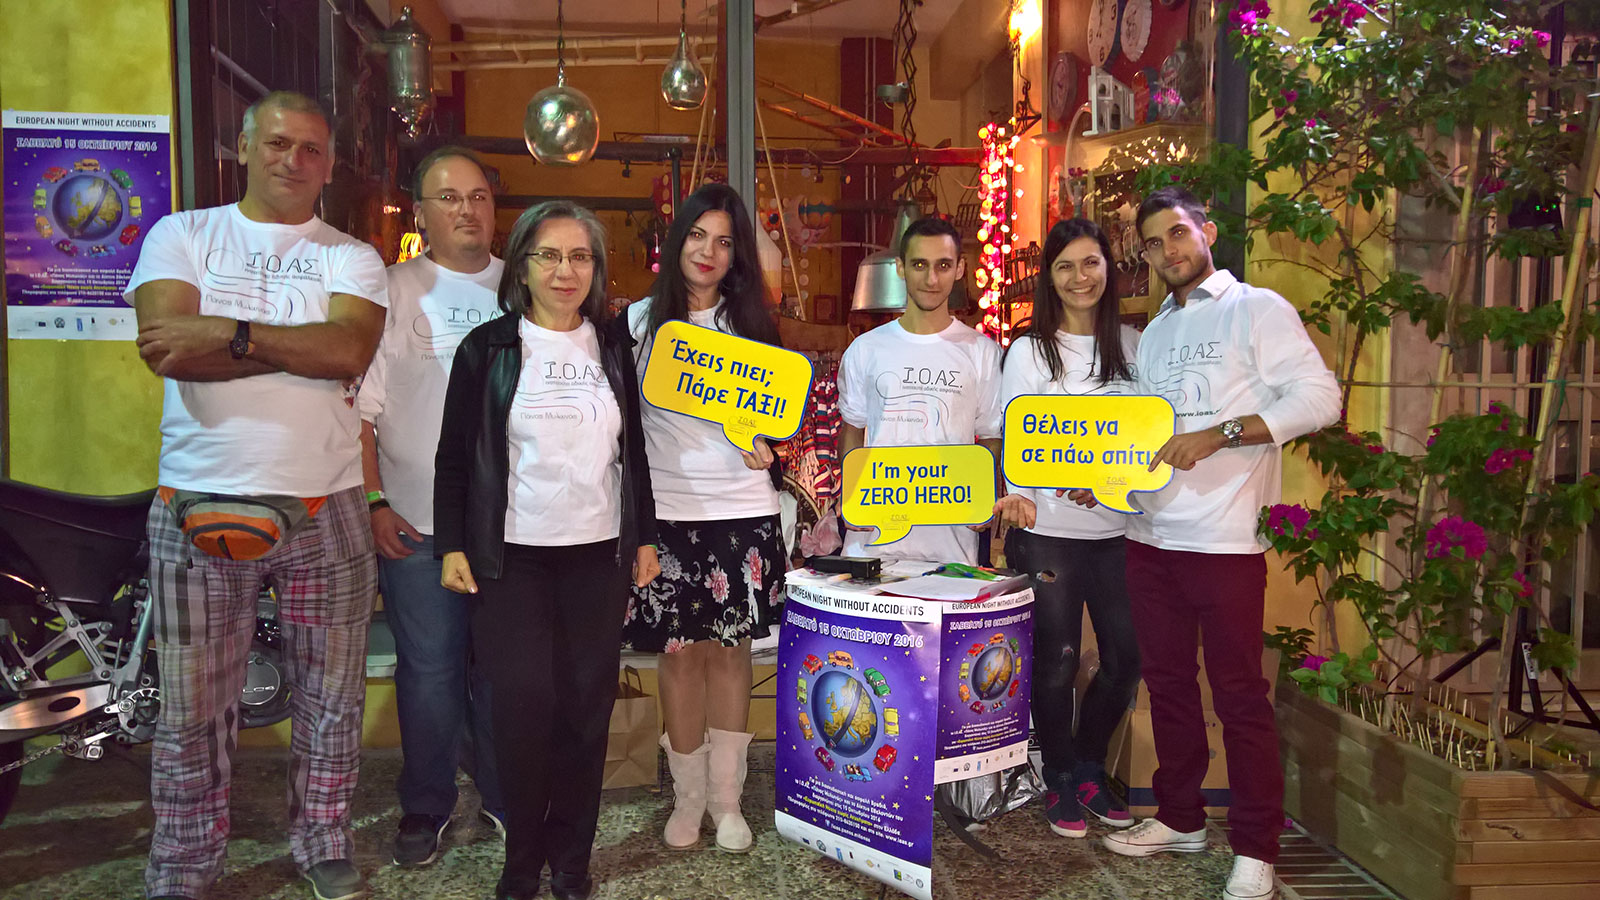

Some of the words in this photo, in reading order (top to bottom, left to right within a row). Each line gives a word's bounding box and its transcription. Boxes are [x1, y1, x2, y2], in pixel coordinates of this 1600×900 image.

[15, 116, 55, 125] EUROPEAN
[57, 117, 79, 126] NIGHT
[81, 118, 114, 127] WITHOUT
[115, 119, 157, 128] ACCIDENTS
[64, 138, 77, 149] 15
[134, 141, 157, 151] 2016
[670, 337, 724, 373] Έχεις
[729, 360, 774, 388] πιει;
[676, 371, 730, 405] Πάρε
[736, 387, 787, 419] ΤΑΞΙ!
[1022, 413, 1088, 437] Θέλεις
[1095, 419, 1119, 436] να
[1021, 448, 1045, 463] σε
[1051, 443, 1094, 464] πάω
[872, 461, 900, 480] I'm
[906, 464, 948, 483] your
[860, 487, 909, 506] ZERO
[915, 485, 972, 504] HERO!
[812, 593, 832, 607] NIGHT
[833, 597, 870, 612] WITHOUT
[872, 603, 924, 616] ACCIDENTS
[952, 602, 981, 610] EUROPEAN
[981, 601, 997, 609] NIGHT
[997, 598, 1014, 607] WITHOUT
[818, 621, 830, 635] 15
[831, 626, 892, 646] ΟΚΤΩΒΡΙΟΥ
[893, 633, 924, 648] 2016
